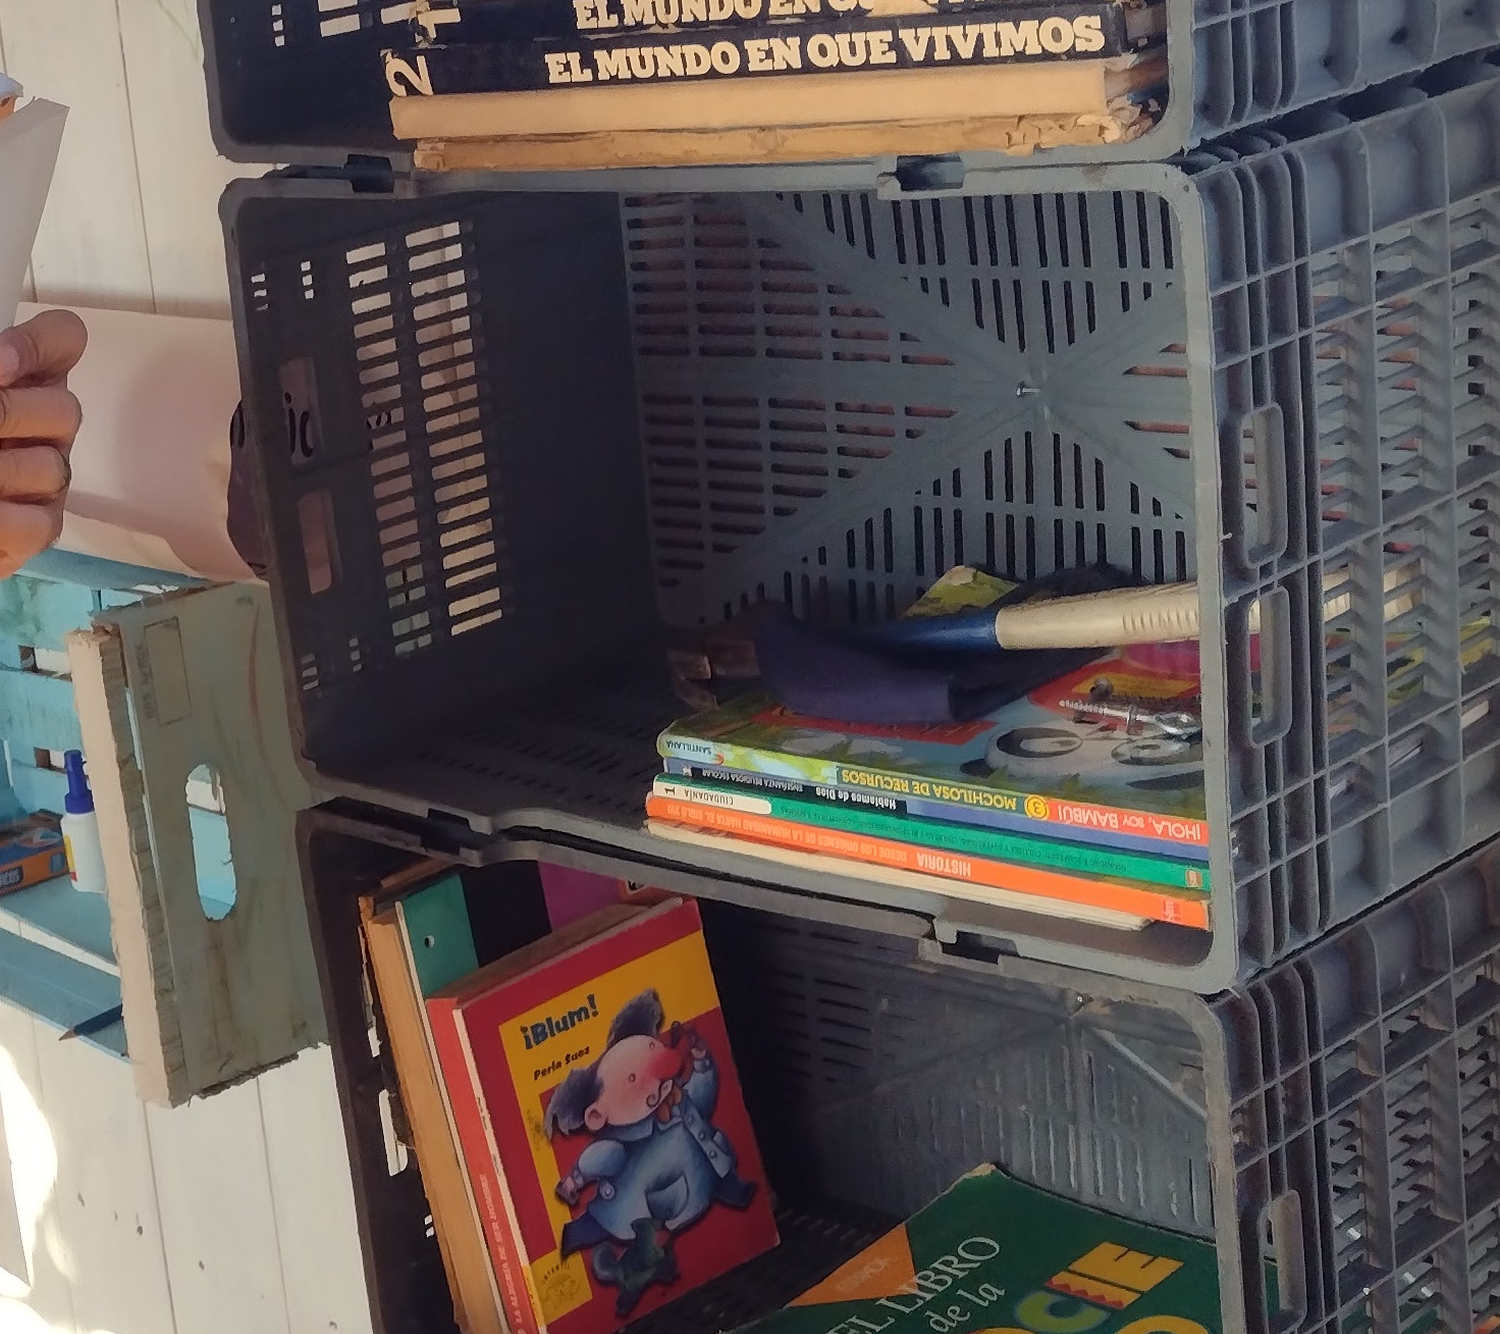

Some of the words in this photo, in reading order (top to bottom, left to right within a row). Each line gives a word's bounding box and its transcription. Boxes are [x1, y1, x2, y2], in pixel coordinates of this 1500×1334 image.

[545, 51, 593, 84] EL
[594, 40, 741, 82] MUNDO
[744, 36, 802, 72] EN
[806, 29, 897, 68] QUE
[899, 15, 1105, 62] VIVIMOS
[666, 740, 711, 756] SANTILLANA
[841, 769, 910, 793] RECURSOS
[911, 780, 930, 794] DE
[684, 789, 734, 806] CIUDADANÍA
[932, 783, 1017, 811] MOCHILOSA
[1032, 798, 1045, 814] 3
[1058, 804, 1119, 830] BAMBÚ!
[916, 852, 971, 877] HISTORIA
[520, 993, 599, 1050] ¡Blum!
[533, 1060, 562, 1081] Perla
[874, 1236, 1000, 1315] LIBRO
[924, 1304, 971, 1334] de
[956, 1282, 1006, 1308] la
